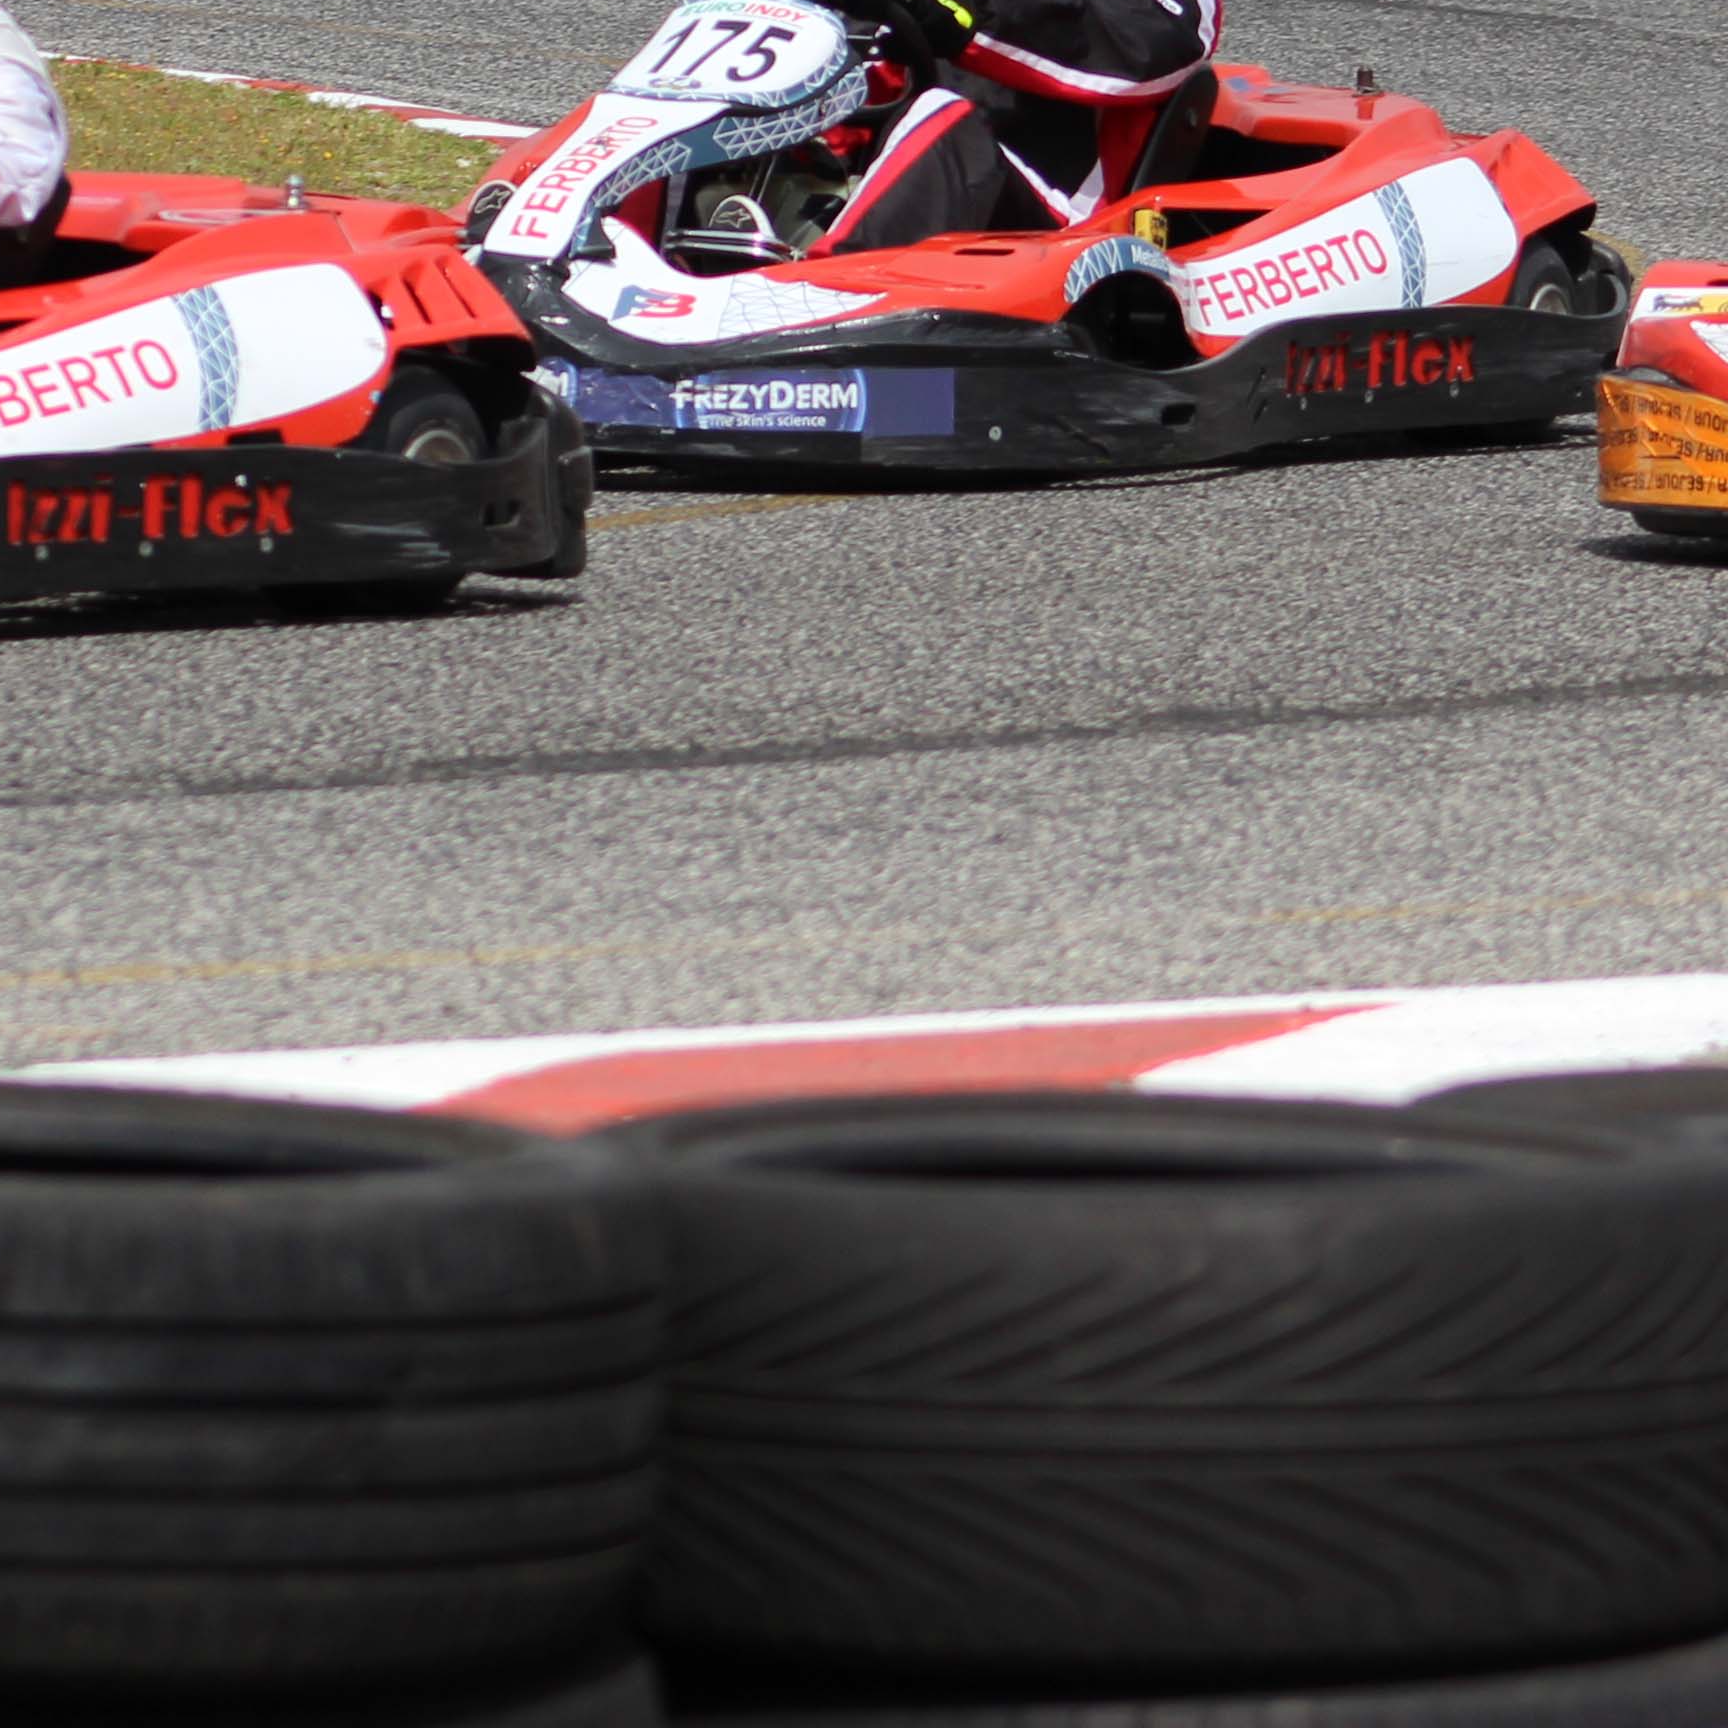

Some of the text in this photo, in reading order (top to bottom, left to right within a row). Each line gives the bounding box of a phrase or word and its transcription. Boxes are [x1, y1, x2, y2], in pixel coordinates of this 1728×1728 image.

[679, 1, 810, 22] EUROINDY
[649, 18, 798, 82] 175
[509, 115, 660, 241] FERBERTO
[1184, 228, 1388, 328] FERBERTO
[670, 379, 859, 412] FREZYDERM
[777, 414, 827, 428] science
